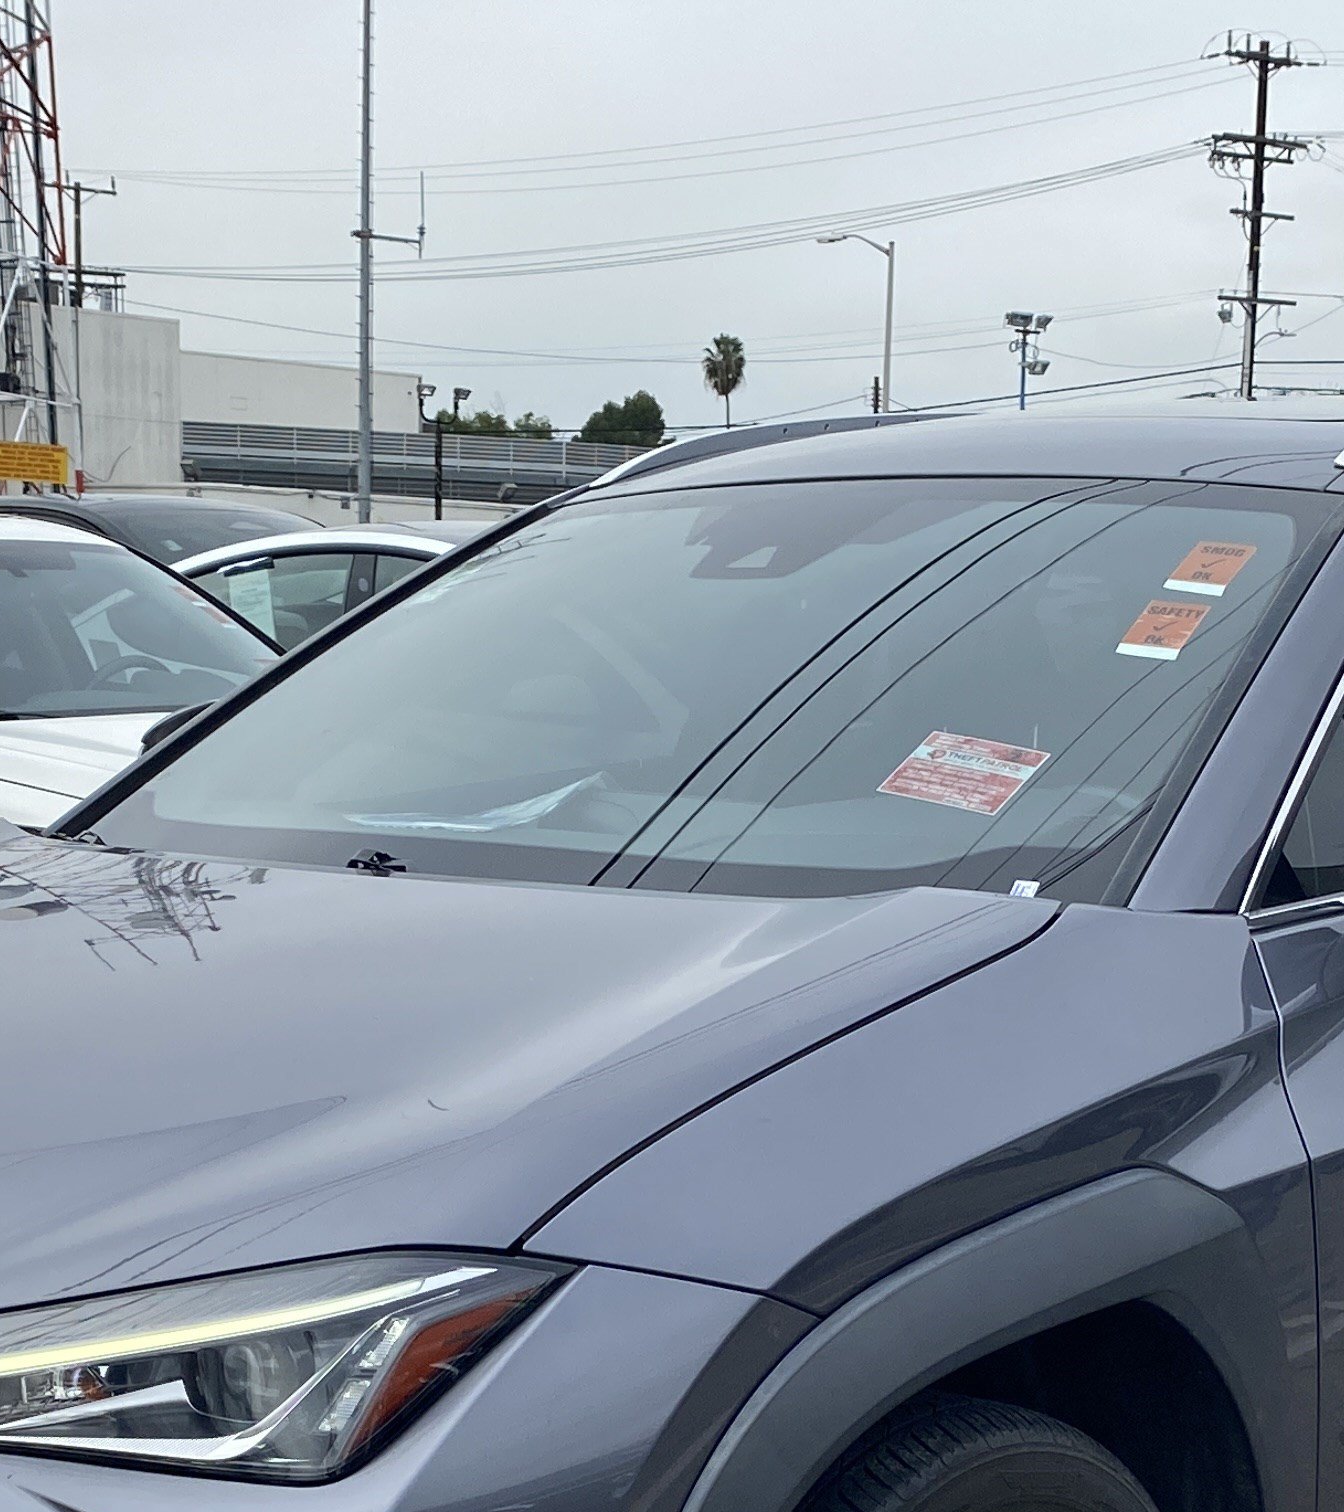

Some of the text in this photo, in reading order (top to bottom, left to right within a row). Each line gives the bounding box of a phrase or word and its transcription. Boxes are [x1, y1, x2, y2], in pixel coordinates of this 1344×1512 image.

[1201, 546, 1246, 557] SMOG
[1191, 571, 1212, 581] OK
[1148, 605, 1204, 619] SAFETY
